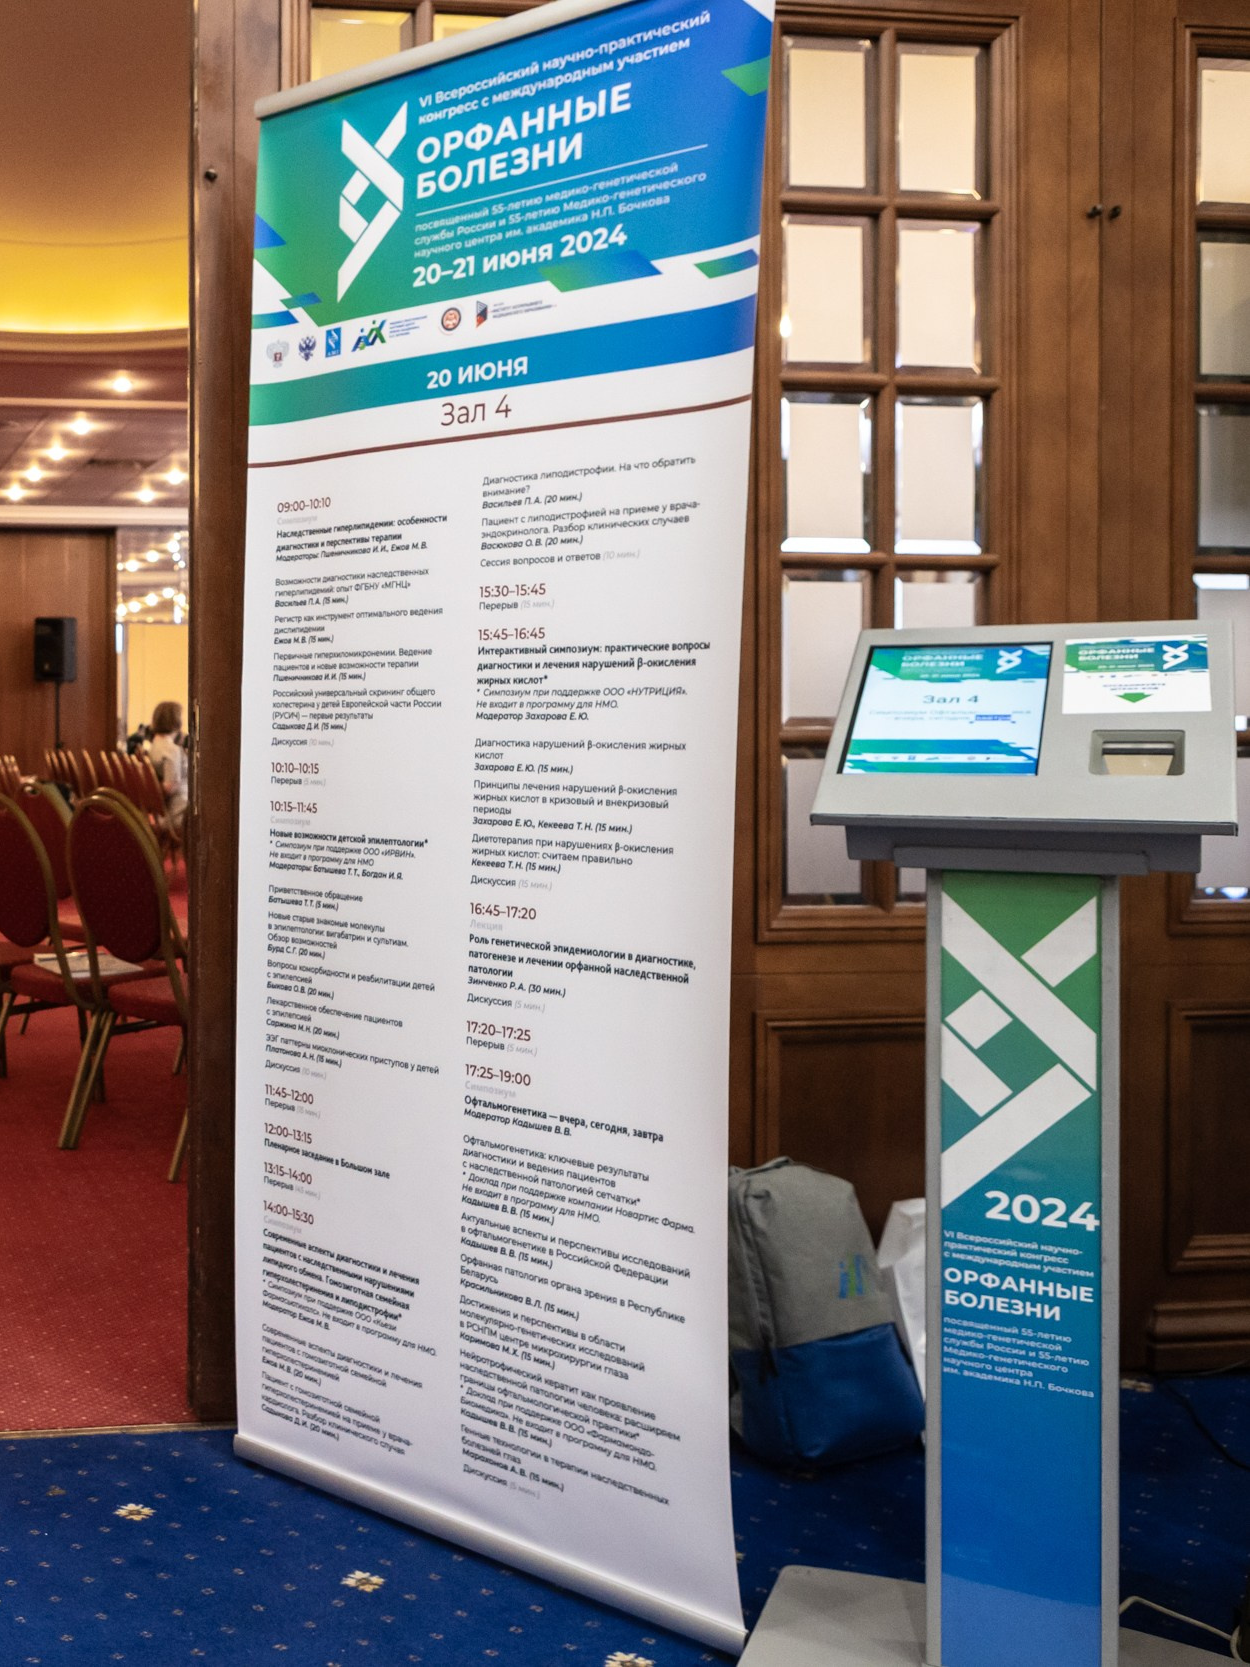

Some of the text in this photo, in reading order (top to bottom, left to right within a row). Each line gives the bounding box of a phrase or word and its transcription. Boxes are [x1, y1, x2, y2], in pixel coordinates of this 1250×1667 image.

[419, 10, 710, 107] VI Всероссийский научно-практический
[418, 100, 478, 124] конгресс
[492, 60, 613, 103] международным
[617, 37, 689, 71] участием
[417, 82, 631, 163] ОРФАННЫЕ
[416, 132, 582, 198] БОЛЕЗНИ
[414, 229, 453, 244] службы
[456, 220, 495, 235] России
[508, 206, 559, 223] 55-летию
[563, 172, 706, 210] Медико-генетического
[415, 162, 678, 231] посвященный 55-летию медико-генетической
[414, 195, 669, 257] научного центра им. академика Н.П. Бочкова
[482, 243, 552, 272] июня
[560, 223, 627, 257] 2024
[427, 356, 527, 388] 20 ИЮНЯ
[441, 394, 511, 425] Зал 4
[482, 456, 695, 486] Диагностика липодистрофии. На что обратить
[482, 484, 529, 497] внимание?
[480, 558, 510, 567] Сессия
[512, 555, 554, 566] вопросов
[565, 552, 600, 562] ответов
[479, 601, 518, 611] Перерыв
[477, 662, 532, 671] диагностики
[542, 660, 579, 669] лечения
[582, 657, 634, 671] нарушений
[637, 657, 695, 670] β-окисления
[478, 641, 710, 656] Интерактивный симпозиум: практические вопросы
[477, 677, 510, 687] жирных
[923, 695, 960, 704] Зал
[468, 950, 515, 962] патогенезе
[525, 956, 562, 968] лечении
[565, 960, 611, 974] орфанной
[614, 967, 688, 983] наследственной
[469, 933, 489, 944] Роль
[491, 937, 550, 951] генетической
[553, 944, 625, 959] эпидемиологии
[635, 954, 695, 969] диагностике,
[468, 964, 512, 977] патологии
[464, 1095, 546, 1118] Офтальмогенетика
[559, 1114, 587, 1128] вчера,
[590, 1121, 629, 1136] сегодня,
[633, 1128, 663, 1142] завтра
[984, 1190, 1099, 1230] 2024
[944, 1229, 1082, 1255] VI Всероссийский научно-
[944, 1241, 1068, 1264] практический конгресс
[951, 1252, 1040, 1269] международным
[1043, 1264, 1093, 1277] участием
[944, 1267, 1092, 1302] ОРФАННЫЕ
[944, 1289, 1060, 1320] БОЛЕЗНИ
